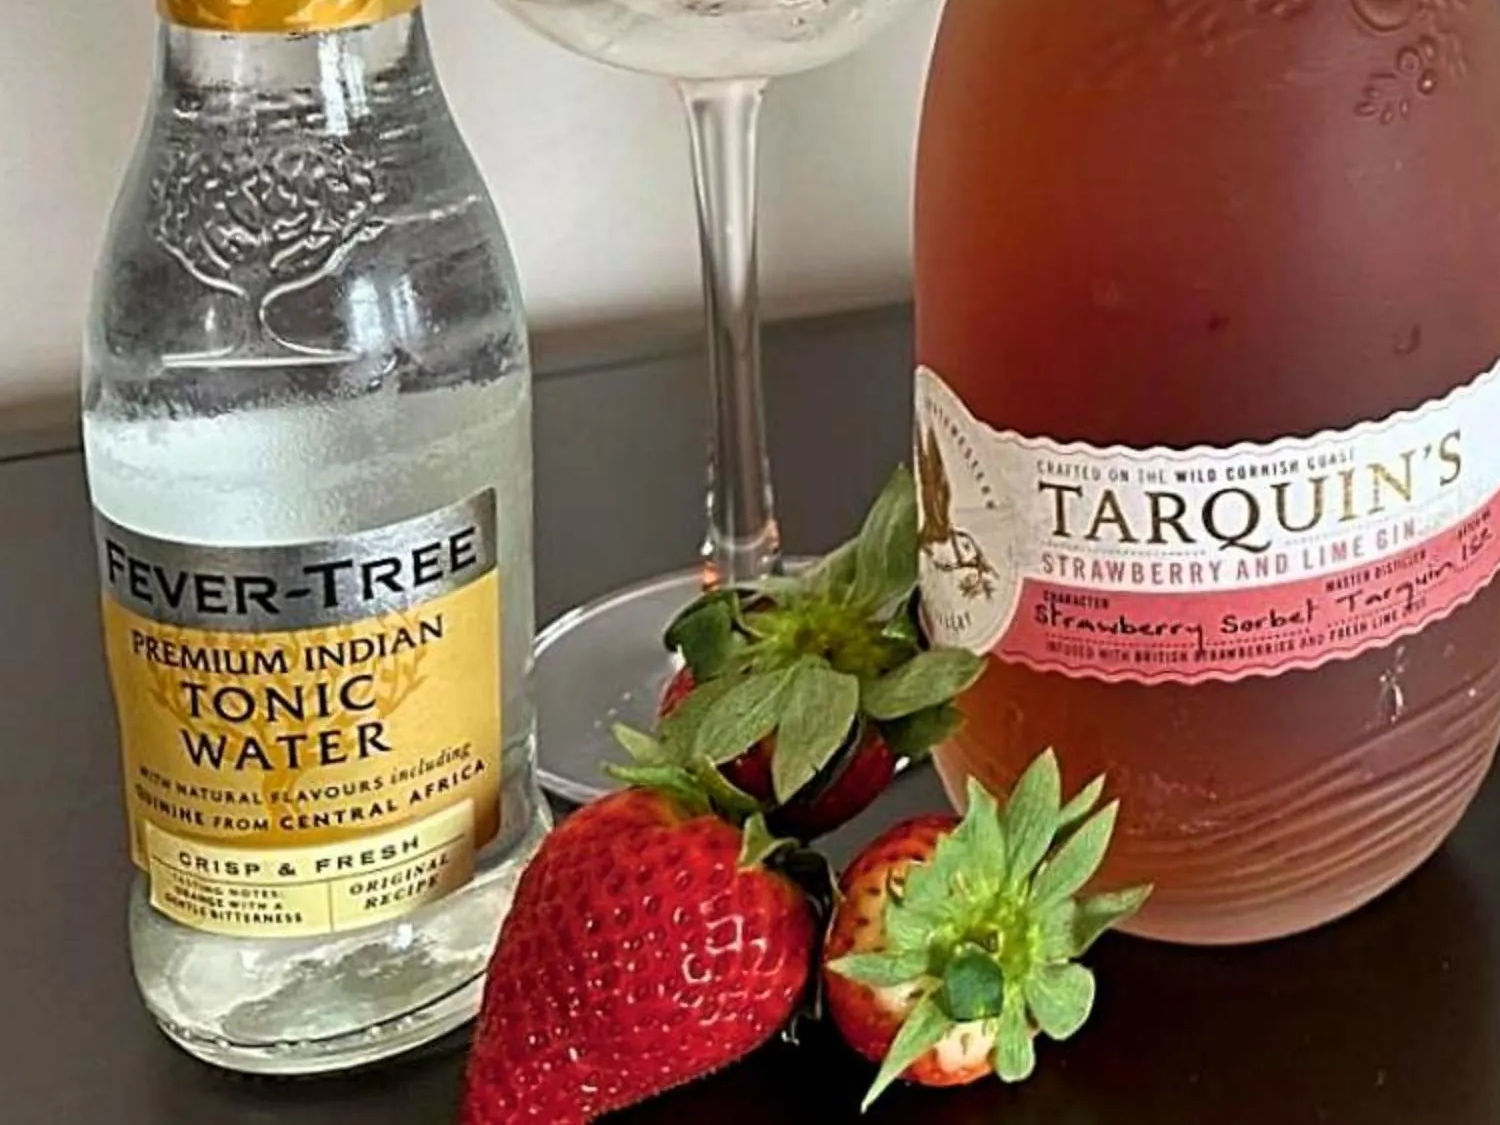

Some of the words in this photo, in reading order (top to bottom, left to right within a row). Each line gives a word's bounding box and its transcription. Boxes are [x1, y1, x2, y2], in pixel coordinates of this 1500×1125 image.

[1036, 458, 1102, 483] CRAFTED
[1108, 467, 1130, 483] ON
[1175, 467, 1217, 484] WILD
[1225, 458, 1301, 482] CORNISH
[1038, 428, 1462, 554] TARQUIN'S
[105, 526, 478, 616] FEVER-TREE
[1041, 552, 1223, 587] STRAWBERRY
[1236, 552, 1289, 581] AND
[1302, 535, 1365, 571] LIME
[1376, 517, 1416, 550] GIN
[131, 629, 289, 675] PREMIUM
[304, 614, 446, 673] INDIAN
[1034, 601, 1204, 654] Strawberry
[1219, 597, 1320, 635] Sorbet
[181, 674, 376, 723] TONIC
[180, 721, 393, 772] WATER
[134, 782, 205, 827] QUININE
[213, 815, 270, 832] FROM
[279, 799, 399, 832] CENTRAL
[409, 758, 486, 806] AFRICA
[139, 766, 172, 790] WITH
[175, 783, 263, 806] NATURAL
[270, 776, 384, 805] FLAVOURS
[390, 742, 472, 786] including
[178, 850, 261, 876] CRISP
[277, 862, 297, 877] &
[315, 835, 420, 874] FRESH
[349, 853, 450, 897] ORIGINAL
[209, 908, 303, 924] BITTERNESS
[363, 873, 441, 911] RECIPE
